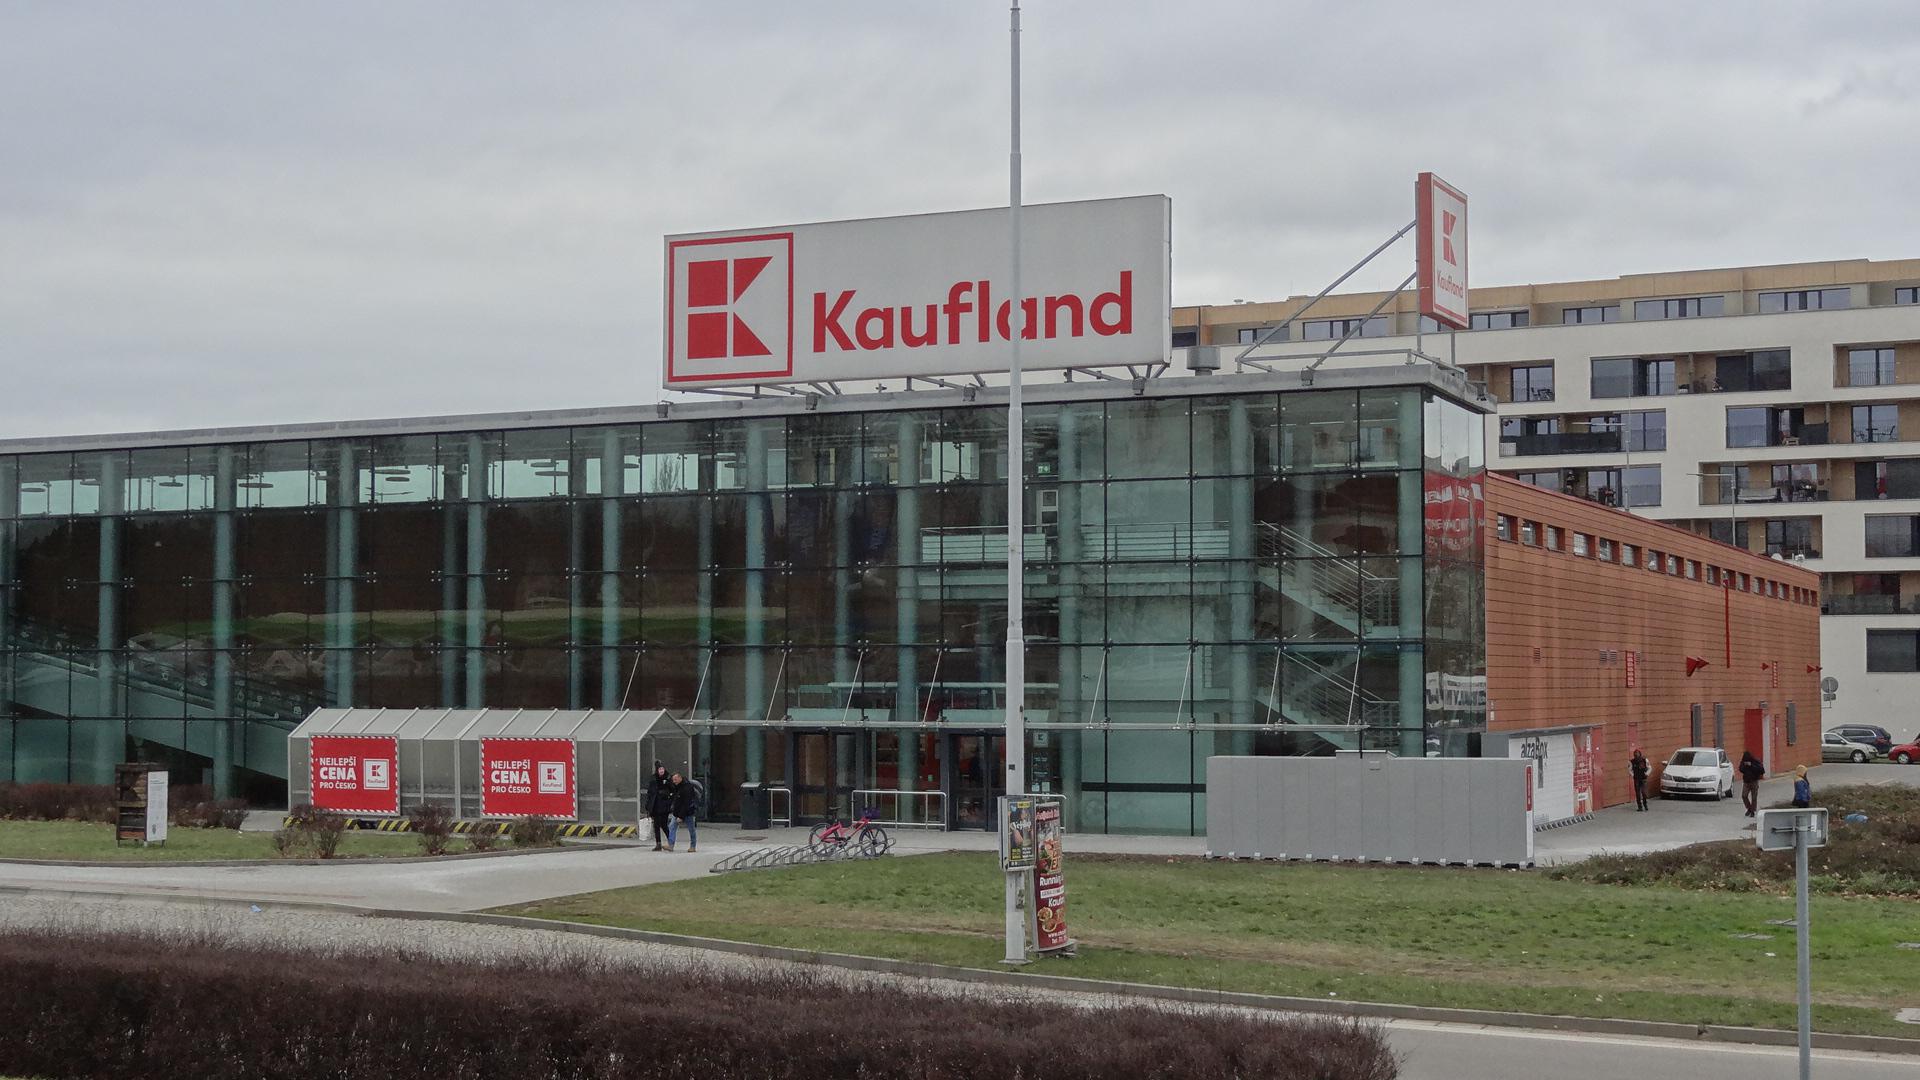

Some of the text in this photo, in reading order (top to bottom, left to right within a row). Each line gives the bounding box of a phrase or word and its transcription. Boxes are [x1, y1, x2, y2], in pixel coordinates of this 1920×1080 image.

[1437, 270, 1463, 299] Kaufland
[687, 255, 773, 360] K
[813, 270, 1133, 353] Kaufland
[319, 756, 357, 766] NEJLEPŠÍ
[491, 759, 531, 770] NEJLEPŠÍ
[319, 767, 357, 780] CENA
[491, 770, 531, 785] CENA
[319, 780, 357, 790] PRO ČESKO
[491, 784, 532, 794] PRO ČESKO
